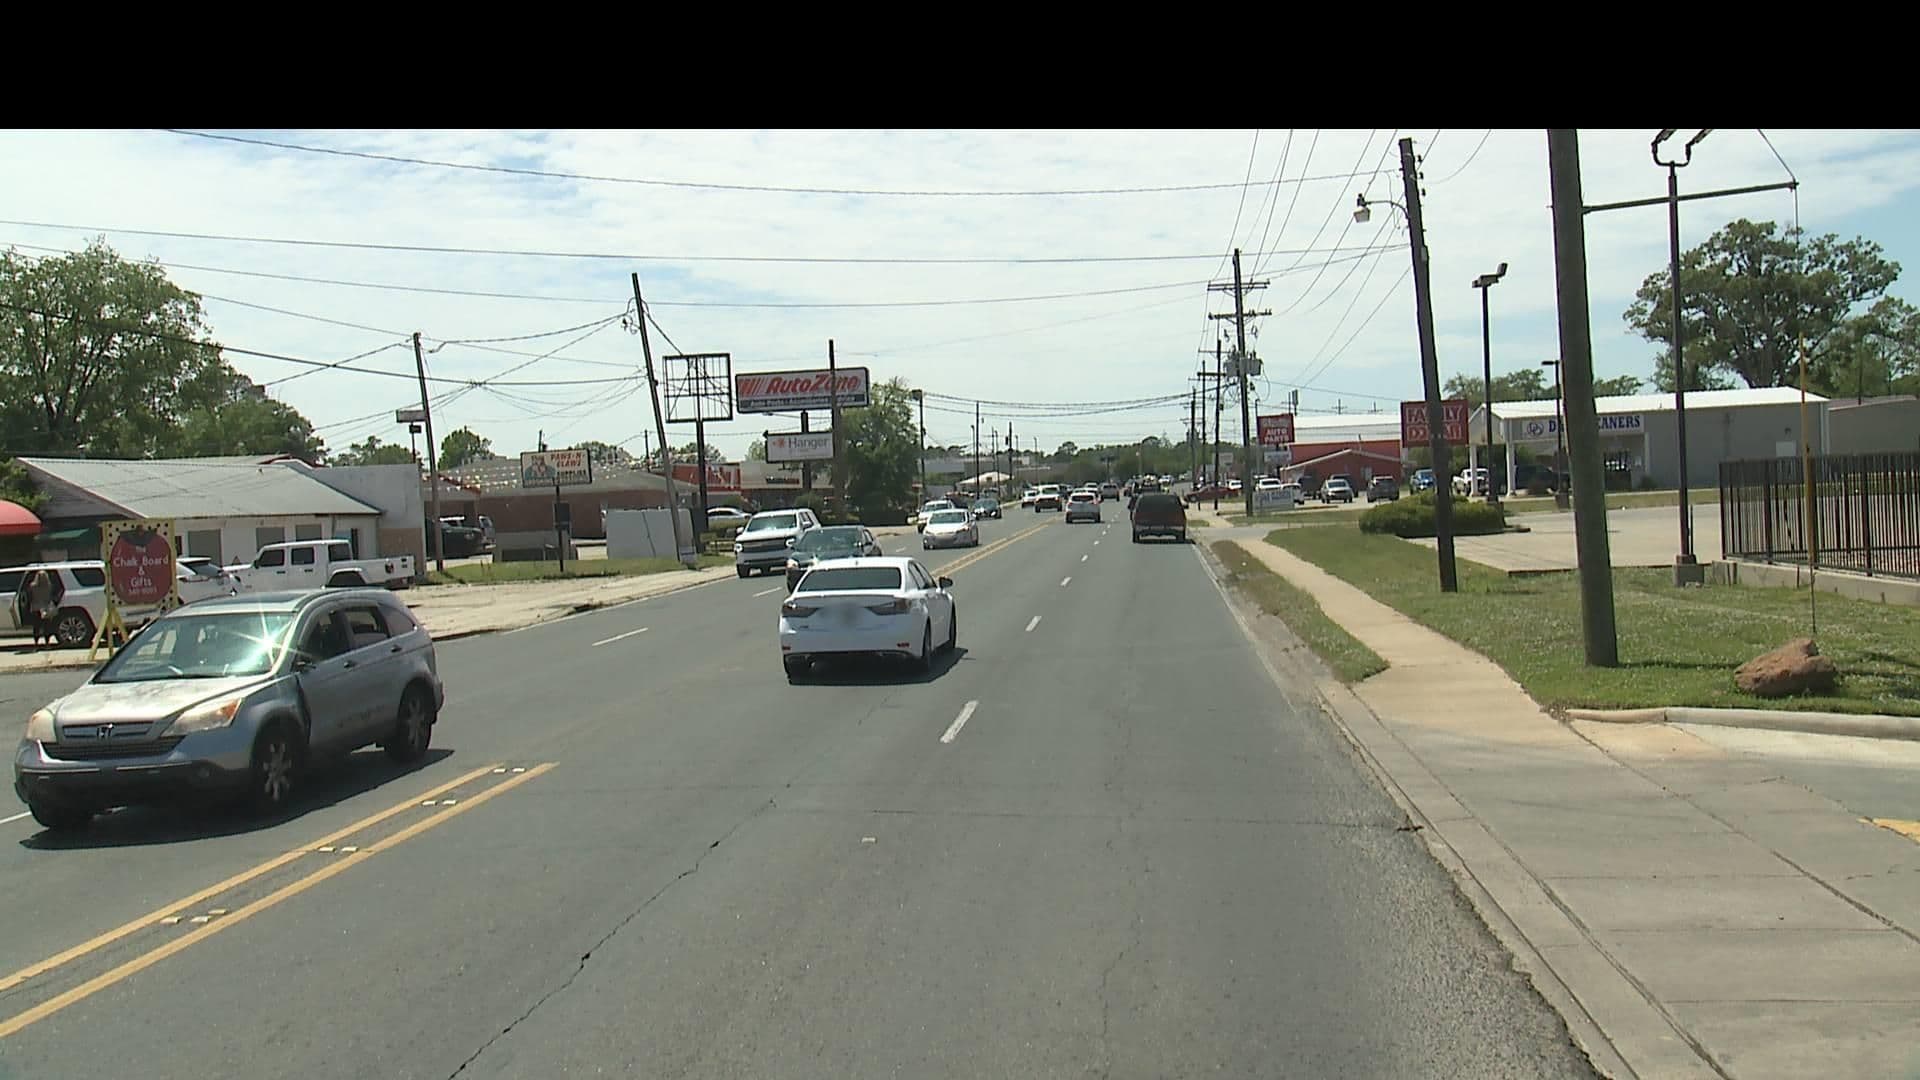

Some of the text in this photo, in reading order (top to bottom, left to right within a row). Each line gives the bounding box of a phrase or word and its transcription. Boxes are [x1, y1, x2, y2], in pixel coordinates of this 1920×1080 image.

[1406, 405, 1463, 425] FALY
[1265, 428, 1288, 436] AUTO
[788, 437, 829, 450] Hanger
[142, 554, 169, 566] Board
[130, 577, 152, 588] Gifts
